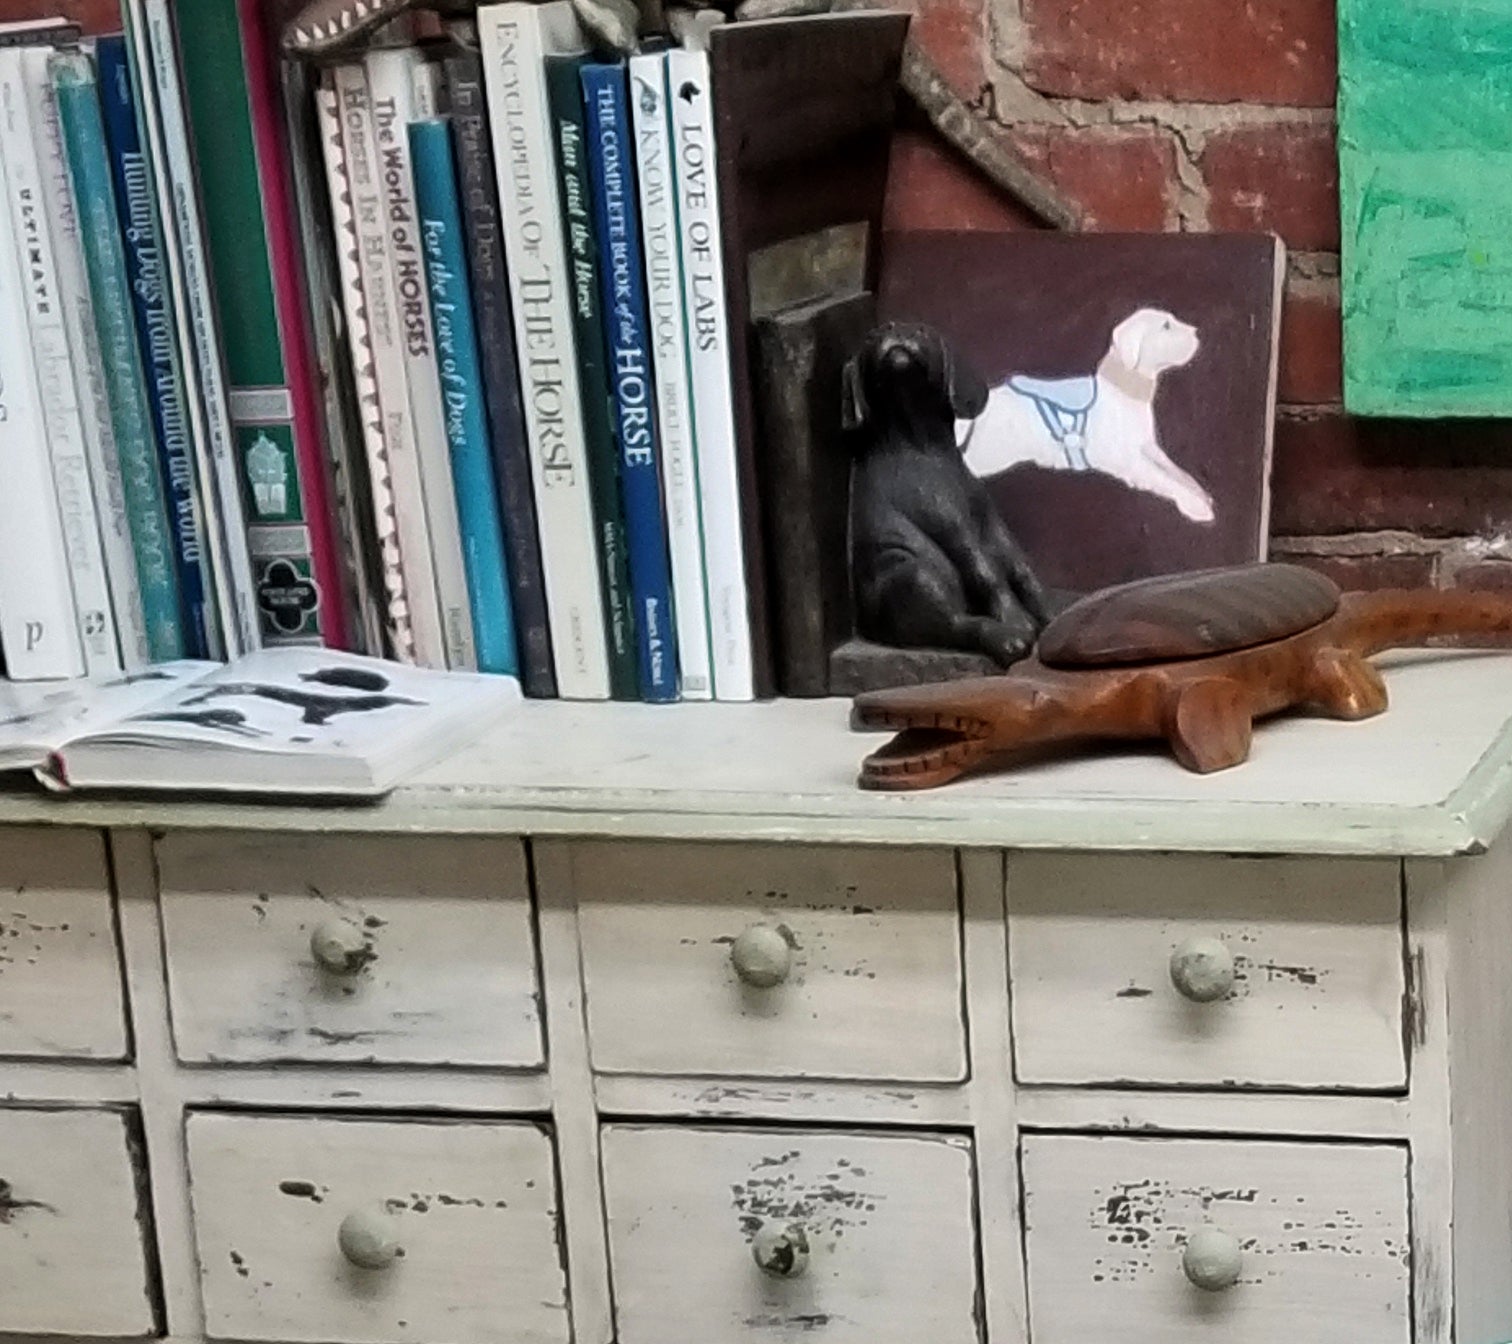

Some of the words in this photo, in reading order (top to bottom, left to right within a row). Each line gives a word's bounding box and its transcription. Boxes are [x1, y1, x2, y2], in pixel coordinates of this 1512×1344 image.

[375, 97, 398, 142] The
[496, 22, 534, 215] ENCYCLOPEDIA
[597, 85, 616, 128] THE
[560, 119, 581, 168] Man
[641, 129, 664, 207] KNOW
[682, 124, 706, 209] LOVE
[383, 146, 411, 222] World
[565, 172, 586, 215] and
[601, 130, 626, 237] COMPLETE
[20, 188, 49, 314] ULTIMATE
[393, 228, 416, 252] of
[423, 219, 445, 258] For
[571, 222, 592, 256] the
[650, 222, 670, 292] YOUR
[689, 221, 711, 262] OF
[431, 262, 454, 298] the
[574, 260, 593, 319] Horse
[611, 241, 630, 298] BOOK
[399, 260, 428, 357] HORSES
[435, 302, 458, 354] Love
[520, 263, 557, 351] THE
[613, 302, 628, 324] of
[619, 321, 633, 345] the
[655, 300, 676, 358] DOG
[693, 274, 718, 352] LABS
[134, 246, 166, 304] Dogs
[156, 368, 187, 452] Around
[441, 358, 466, 386] of
[447, 391, 469, 447] Dogs
[529, 358, 575, 489] HORSE
[616, 345, 653, 468] HORSE
